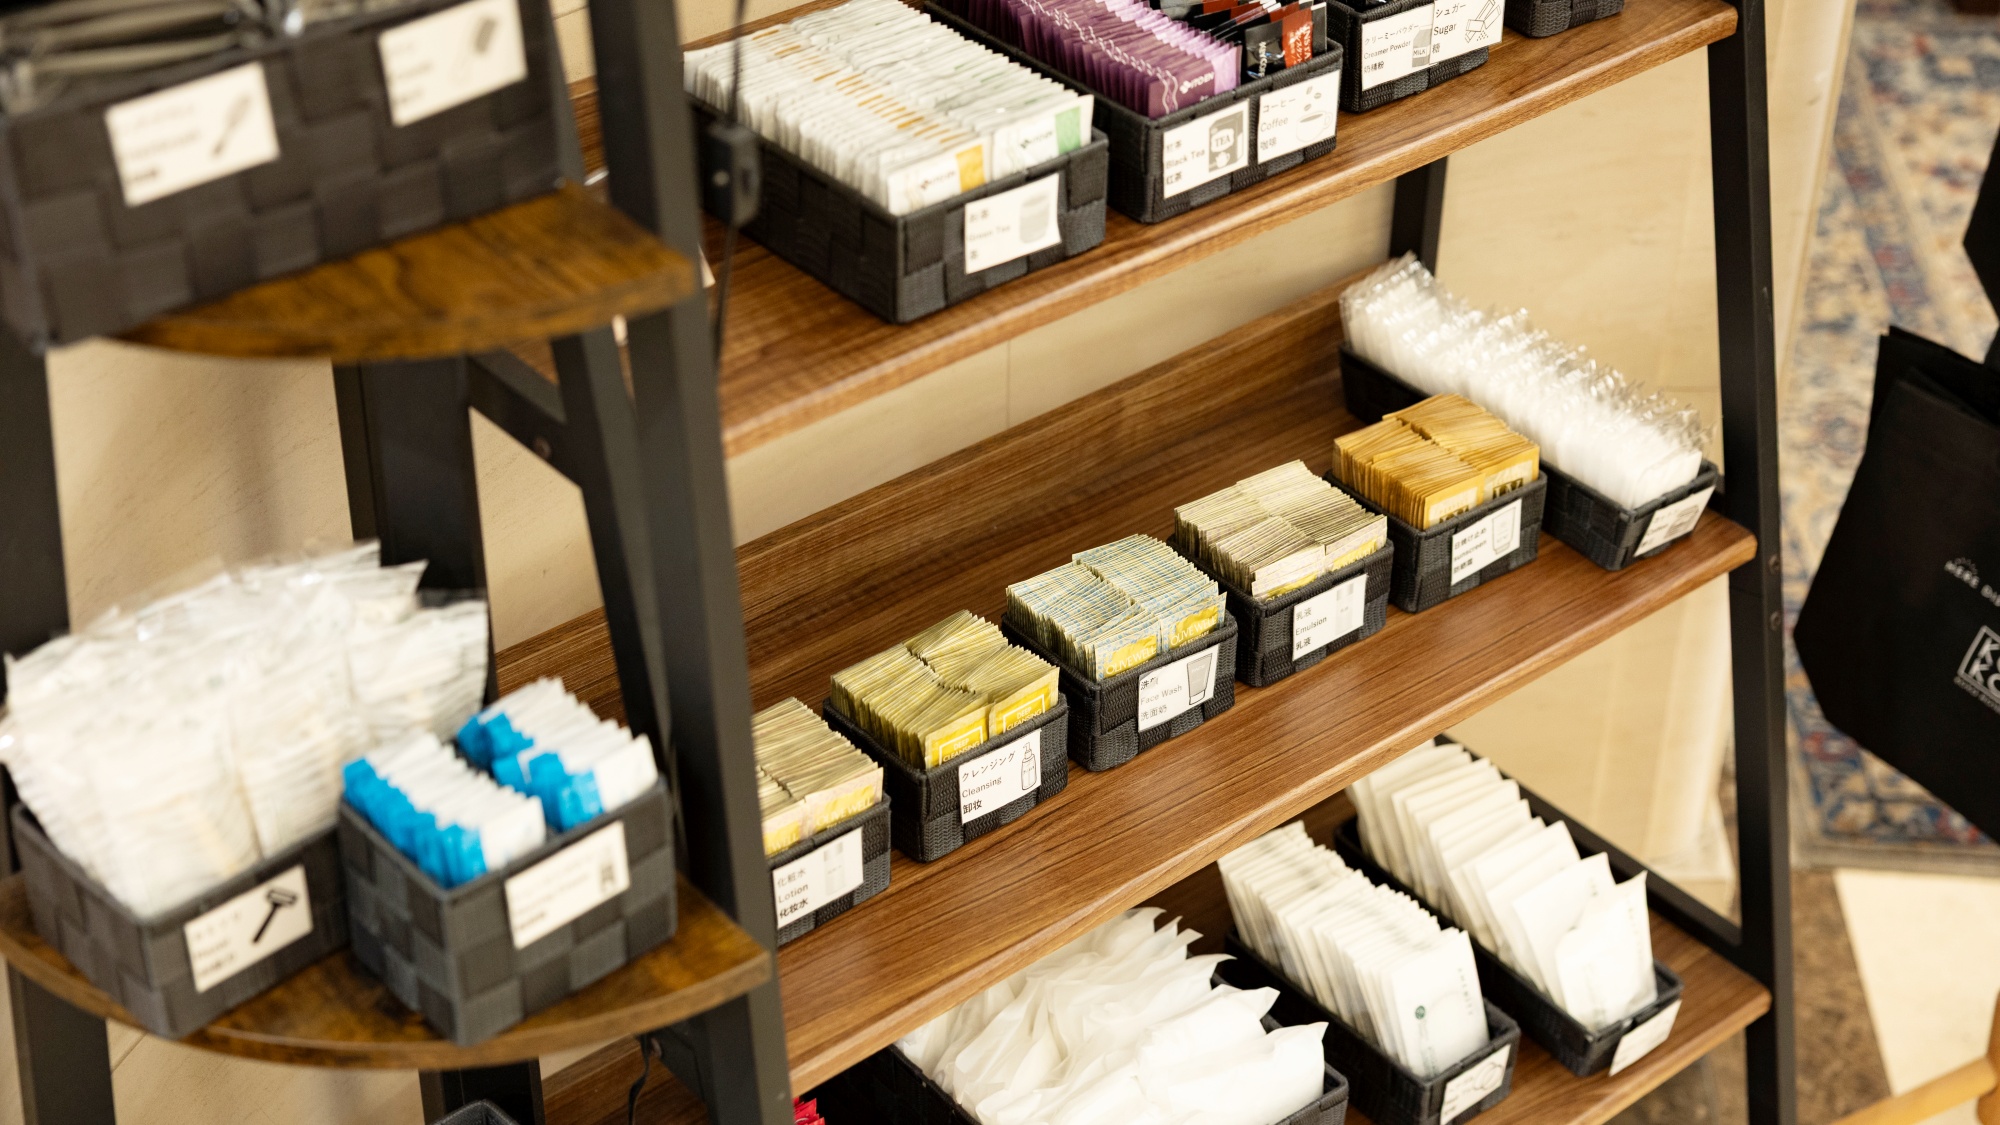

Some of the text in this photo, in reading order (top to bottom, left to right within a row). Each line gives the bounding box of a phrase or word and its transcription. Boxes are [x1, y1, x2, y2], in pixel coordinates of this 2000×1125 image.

[1435, 3, 1467, 18] シュガー
[1433, 23, 1457, 36] Sugar
[1363, 40, 1411, 60] Creamer Powder
[1262, 97, 1297, 114] コーヒー
[1260, 117, 1289, 132] Coffee
[1215, 134, 1231, 147] TEA
[1166, 149, 1206, 169] Black Tea
[1295, 616, 1328, 636] Emulsion
[1140, 684, 1183, 706] Face Wash
[1016, 706, 1033, 720] DEEP
[953, 738, 970, 751] DEEP
[962, 750, 1016, 783] クレンジング
[961, 776, 1003, 799] Cleansing
[778, 884, 809, 904] Lotion
